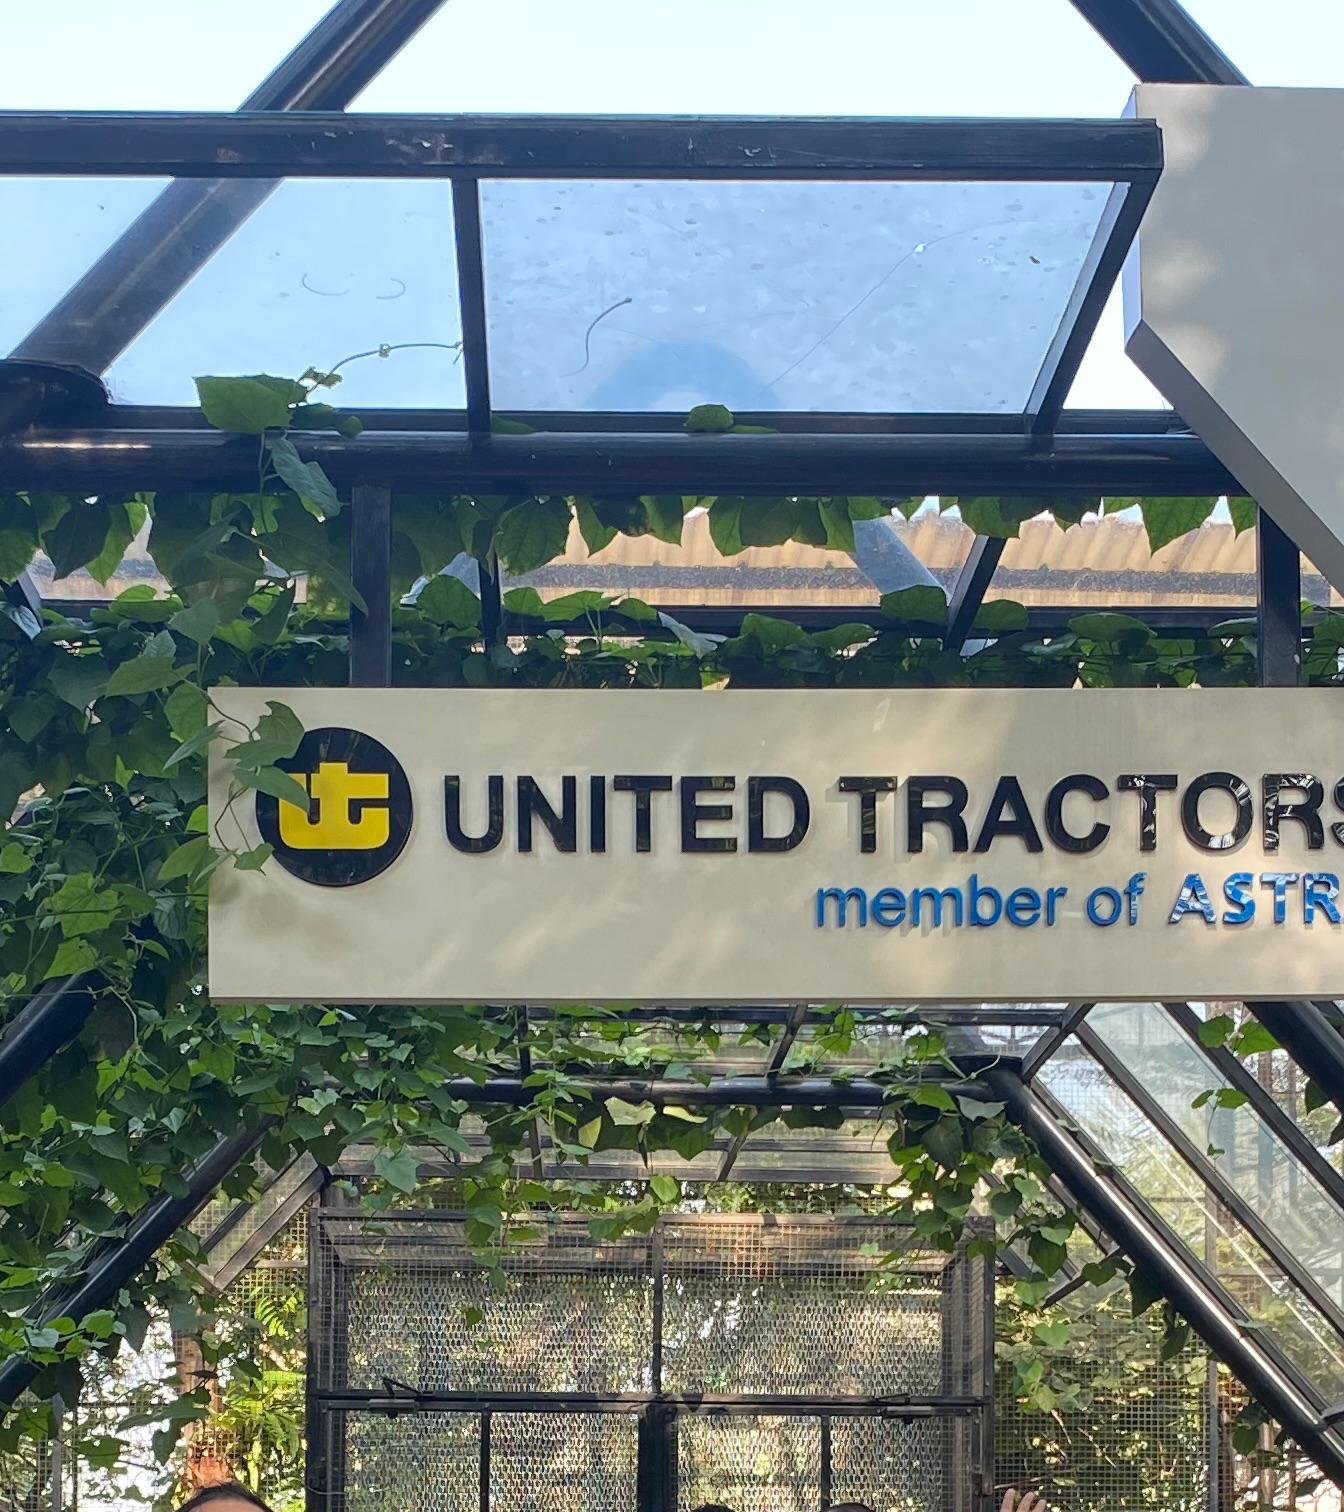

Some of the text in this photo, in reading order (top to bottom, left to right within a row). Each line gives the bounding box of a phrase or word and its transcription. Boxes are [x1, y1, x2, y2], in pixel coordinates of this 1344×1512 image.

[444, 775, 810, 853] UNITED
[815, 873, 1065, 928] member
[1087, 872, 1148, 926] of
